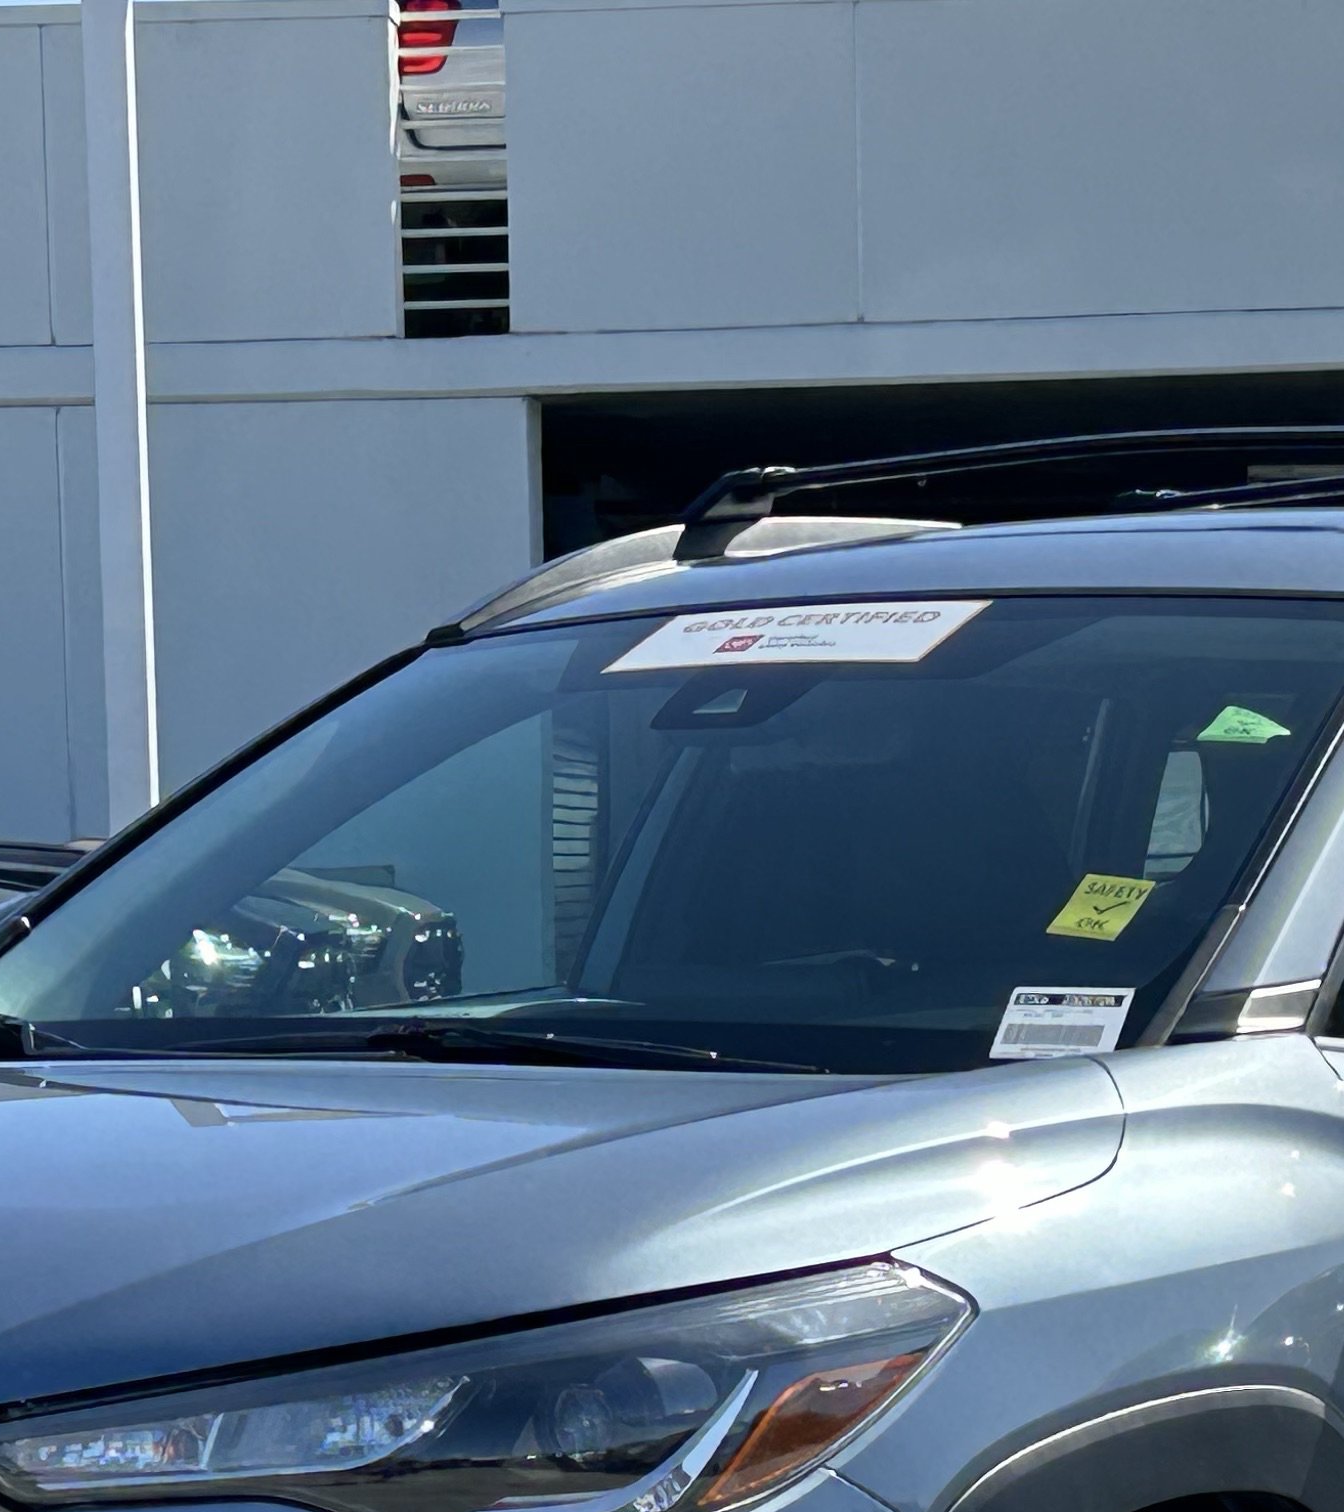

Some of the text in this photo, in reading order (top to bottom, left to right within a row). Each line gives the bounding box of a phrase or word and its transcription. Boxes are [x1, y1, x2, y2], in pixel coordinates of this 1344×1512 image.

[683, 610, 942, 633] GOLD CERTIFIED
[1084, 881, 1149, 900] SAFETY
